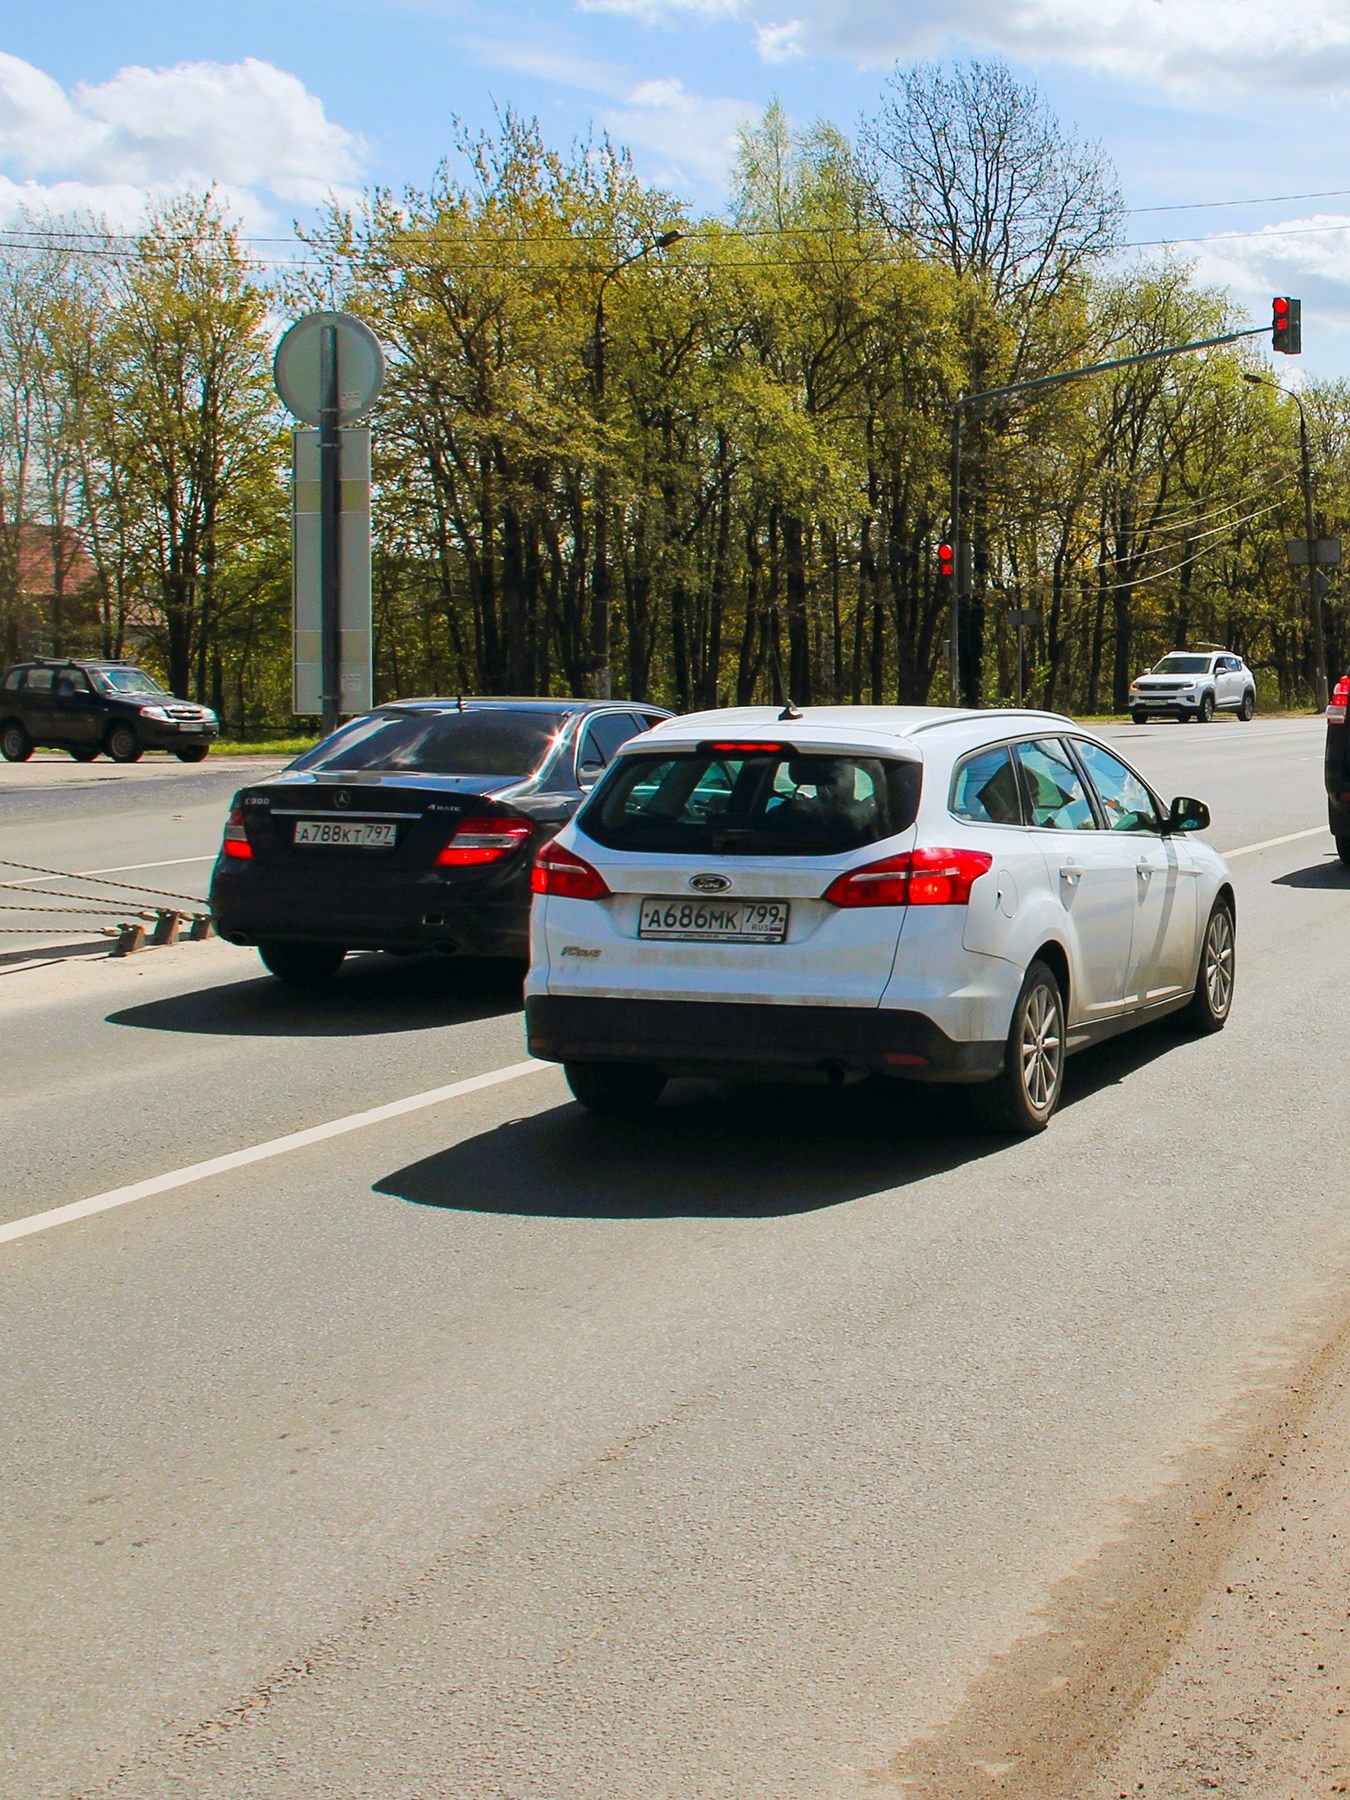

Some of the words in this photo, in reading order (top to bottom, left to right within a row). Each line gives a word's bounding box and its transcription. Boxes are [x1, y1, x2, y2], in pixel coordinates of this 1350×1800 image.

[366, 825, 392, 840] 797
[745, 904, 780, 924] 799
[751, 923, 769, 931] RUS
